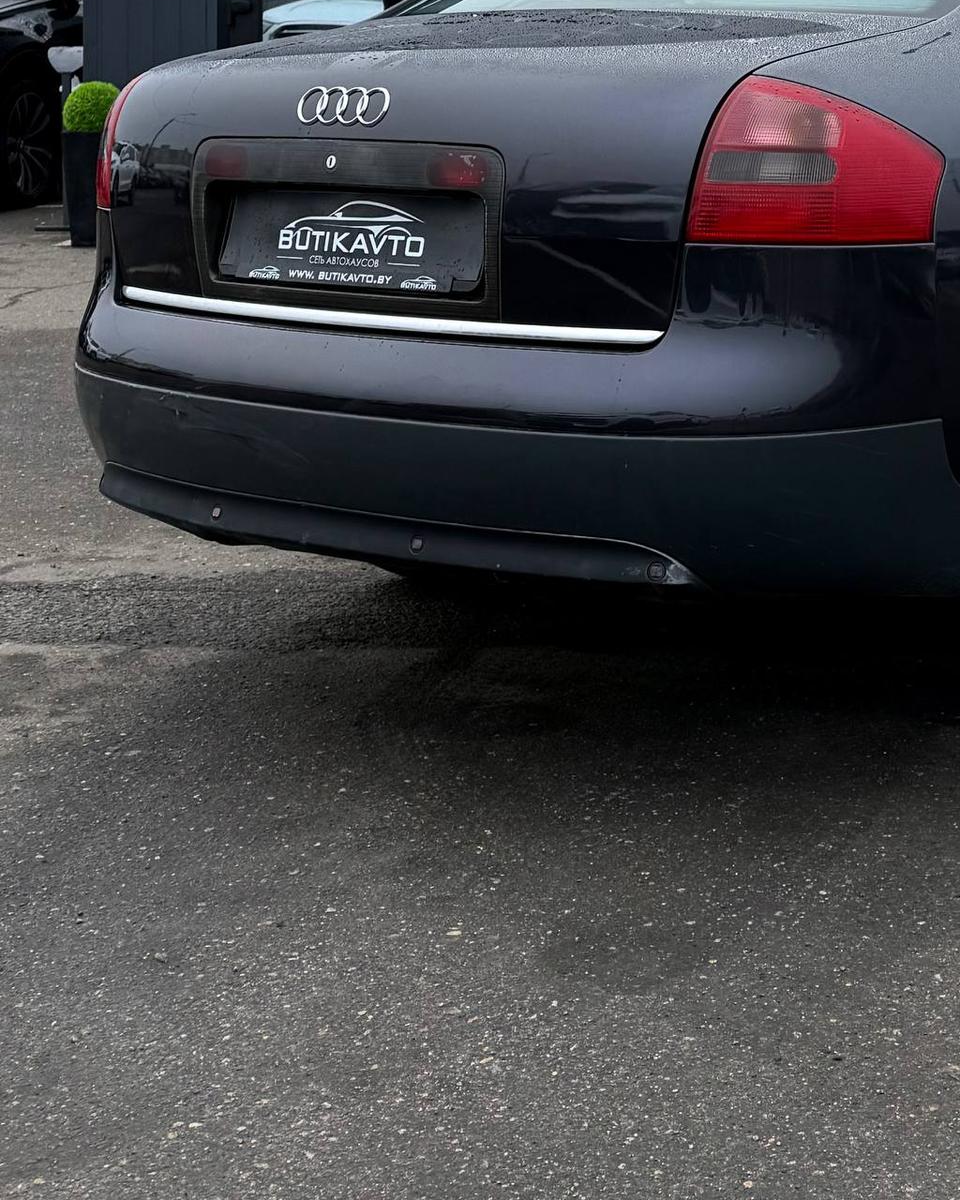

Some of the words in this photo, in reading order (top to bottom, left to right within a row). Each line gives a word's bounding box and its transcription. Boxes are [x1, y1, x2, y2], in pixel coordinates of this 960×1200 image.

[277, 228, 426, 258] BUTIKAVTO
[308, 255, 325, 265] СЕТЬ
[325, 256, 380, 268] АВТОХАУСОВ
[249, 270, 281, 280] BUTIKAVTO
[288, 269, 315, 280] WWW.
[317, 271, 393, 285] BUTIKAVTO.BY
[400, 281, 437, 291] BUTIKAVTO
